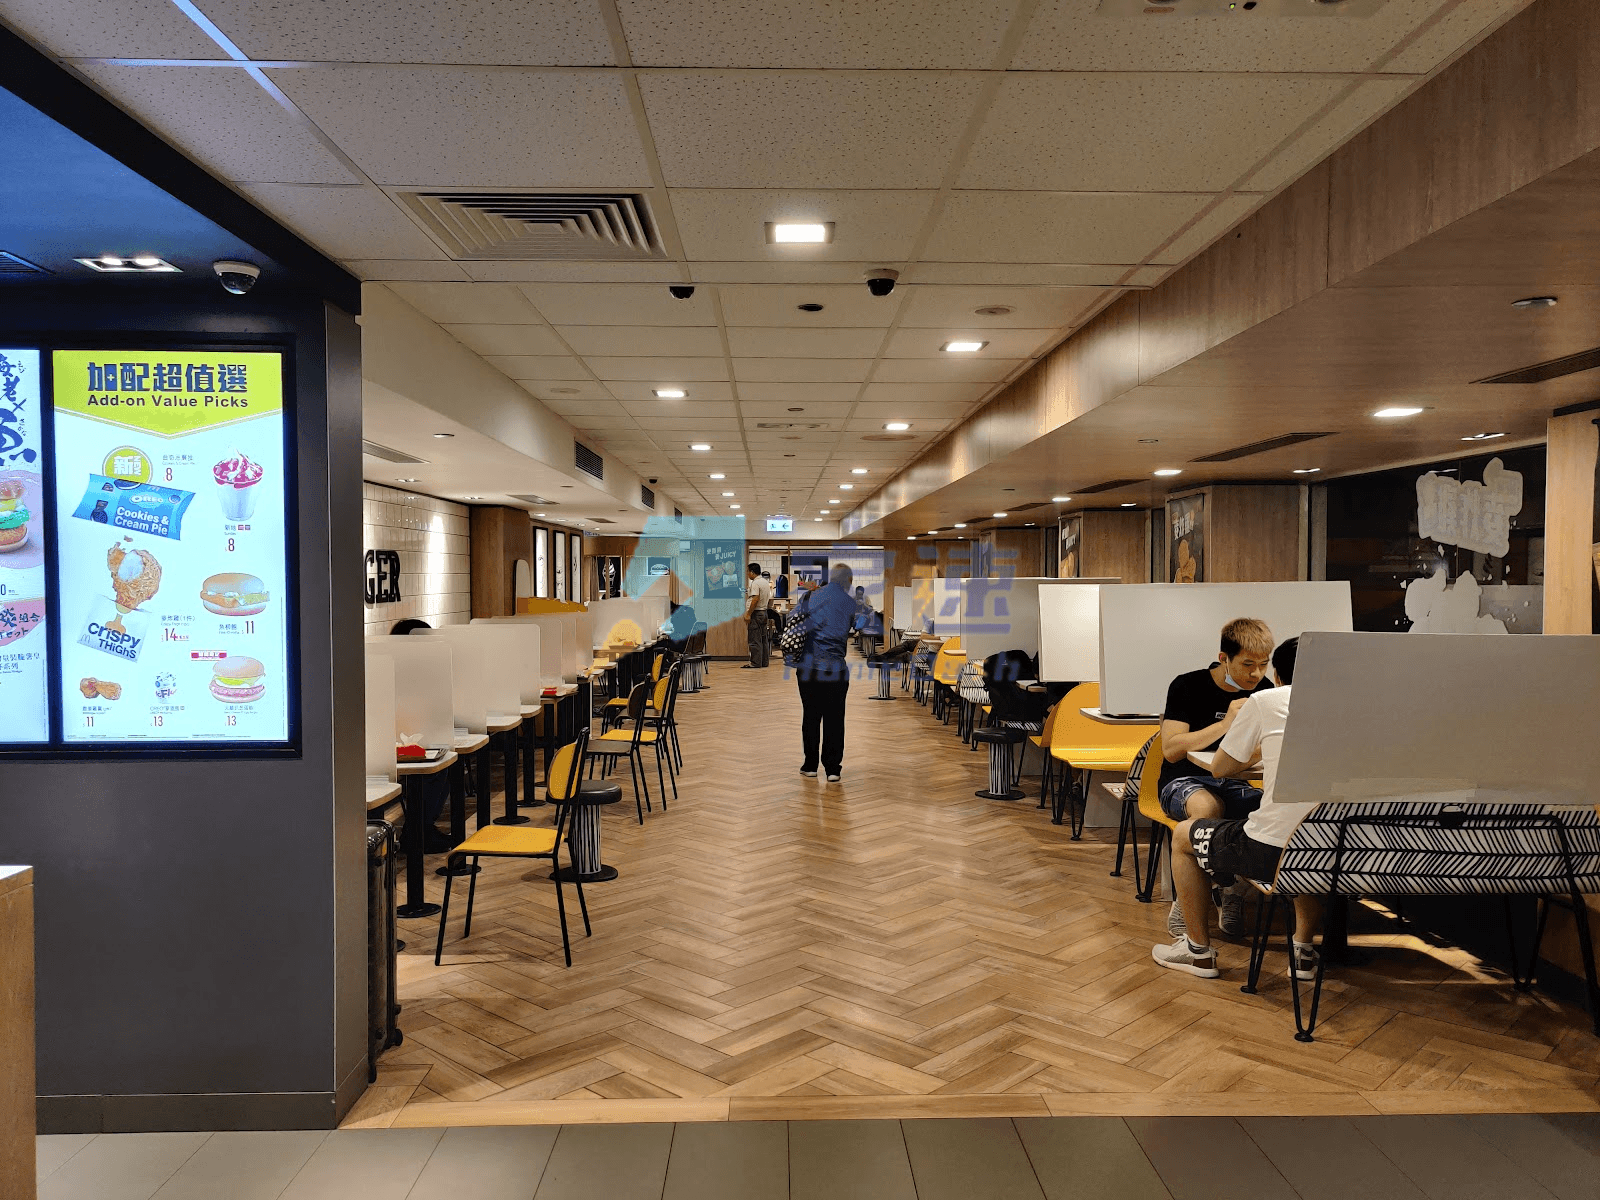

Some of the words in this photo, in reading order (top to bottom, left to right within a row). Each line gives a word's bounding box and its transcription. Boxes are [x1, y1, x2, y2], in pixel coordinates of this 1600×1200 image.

[87, 362, 248, 393] 加配超值選
[87, 395, 146, 407] Add-on
[152, 395, 198, 407] Value
[204, 396, 249, 408] Picks
[115, 516, 149, 532] Cream
[151, 523, 168, 535] Pie
[117, 507, 159, 523] Cookies
[161, 515, 169, 526] &
[364, 549, 402, 605] GER
[154, 715, 163, 727] 13
[227, 715, 237, 727] 13
